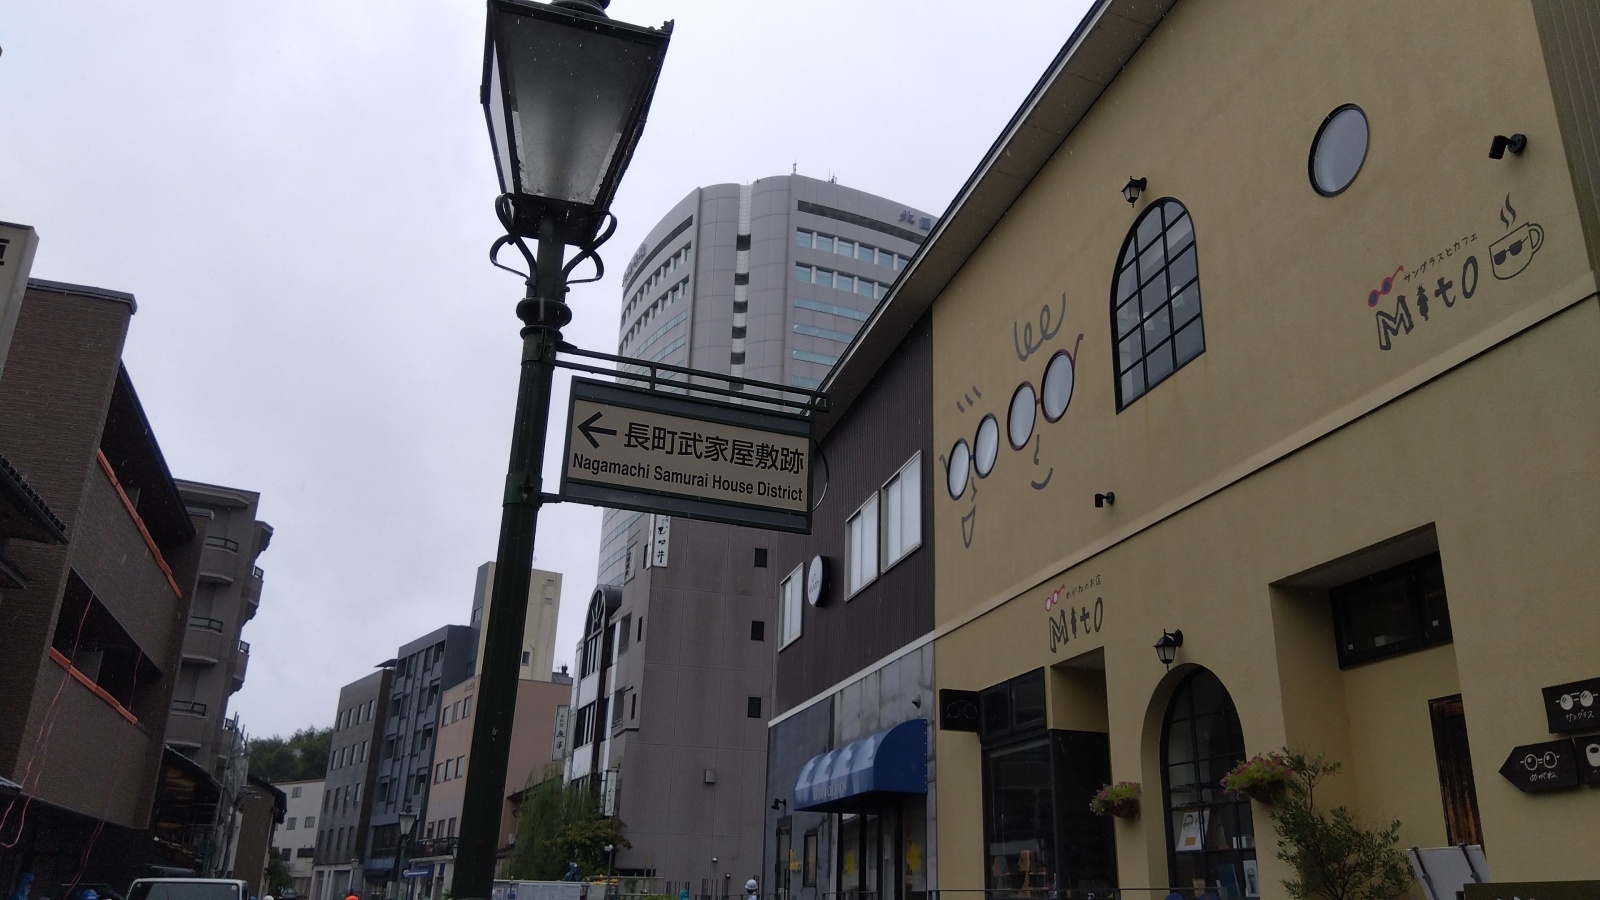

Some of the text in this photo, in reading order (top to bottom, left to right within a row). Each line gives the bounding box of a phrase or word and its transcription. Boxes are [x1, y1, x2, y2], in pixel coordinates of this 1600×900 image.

[1404, 233, 1478, 282] サングラスとカフェ
[624, 421, 804, 475] 長町武家屋敷跡
[572, 452, 803, 502] Nagamachi Samurai House District
